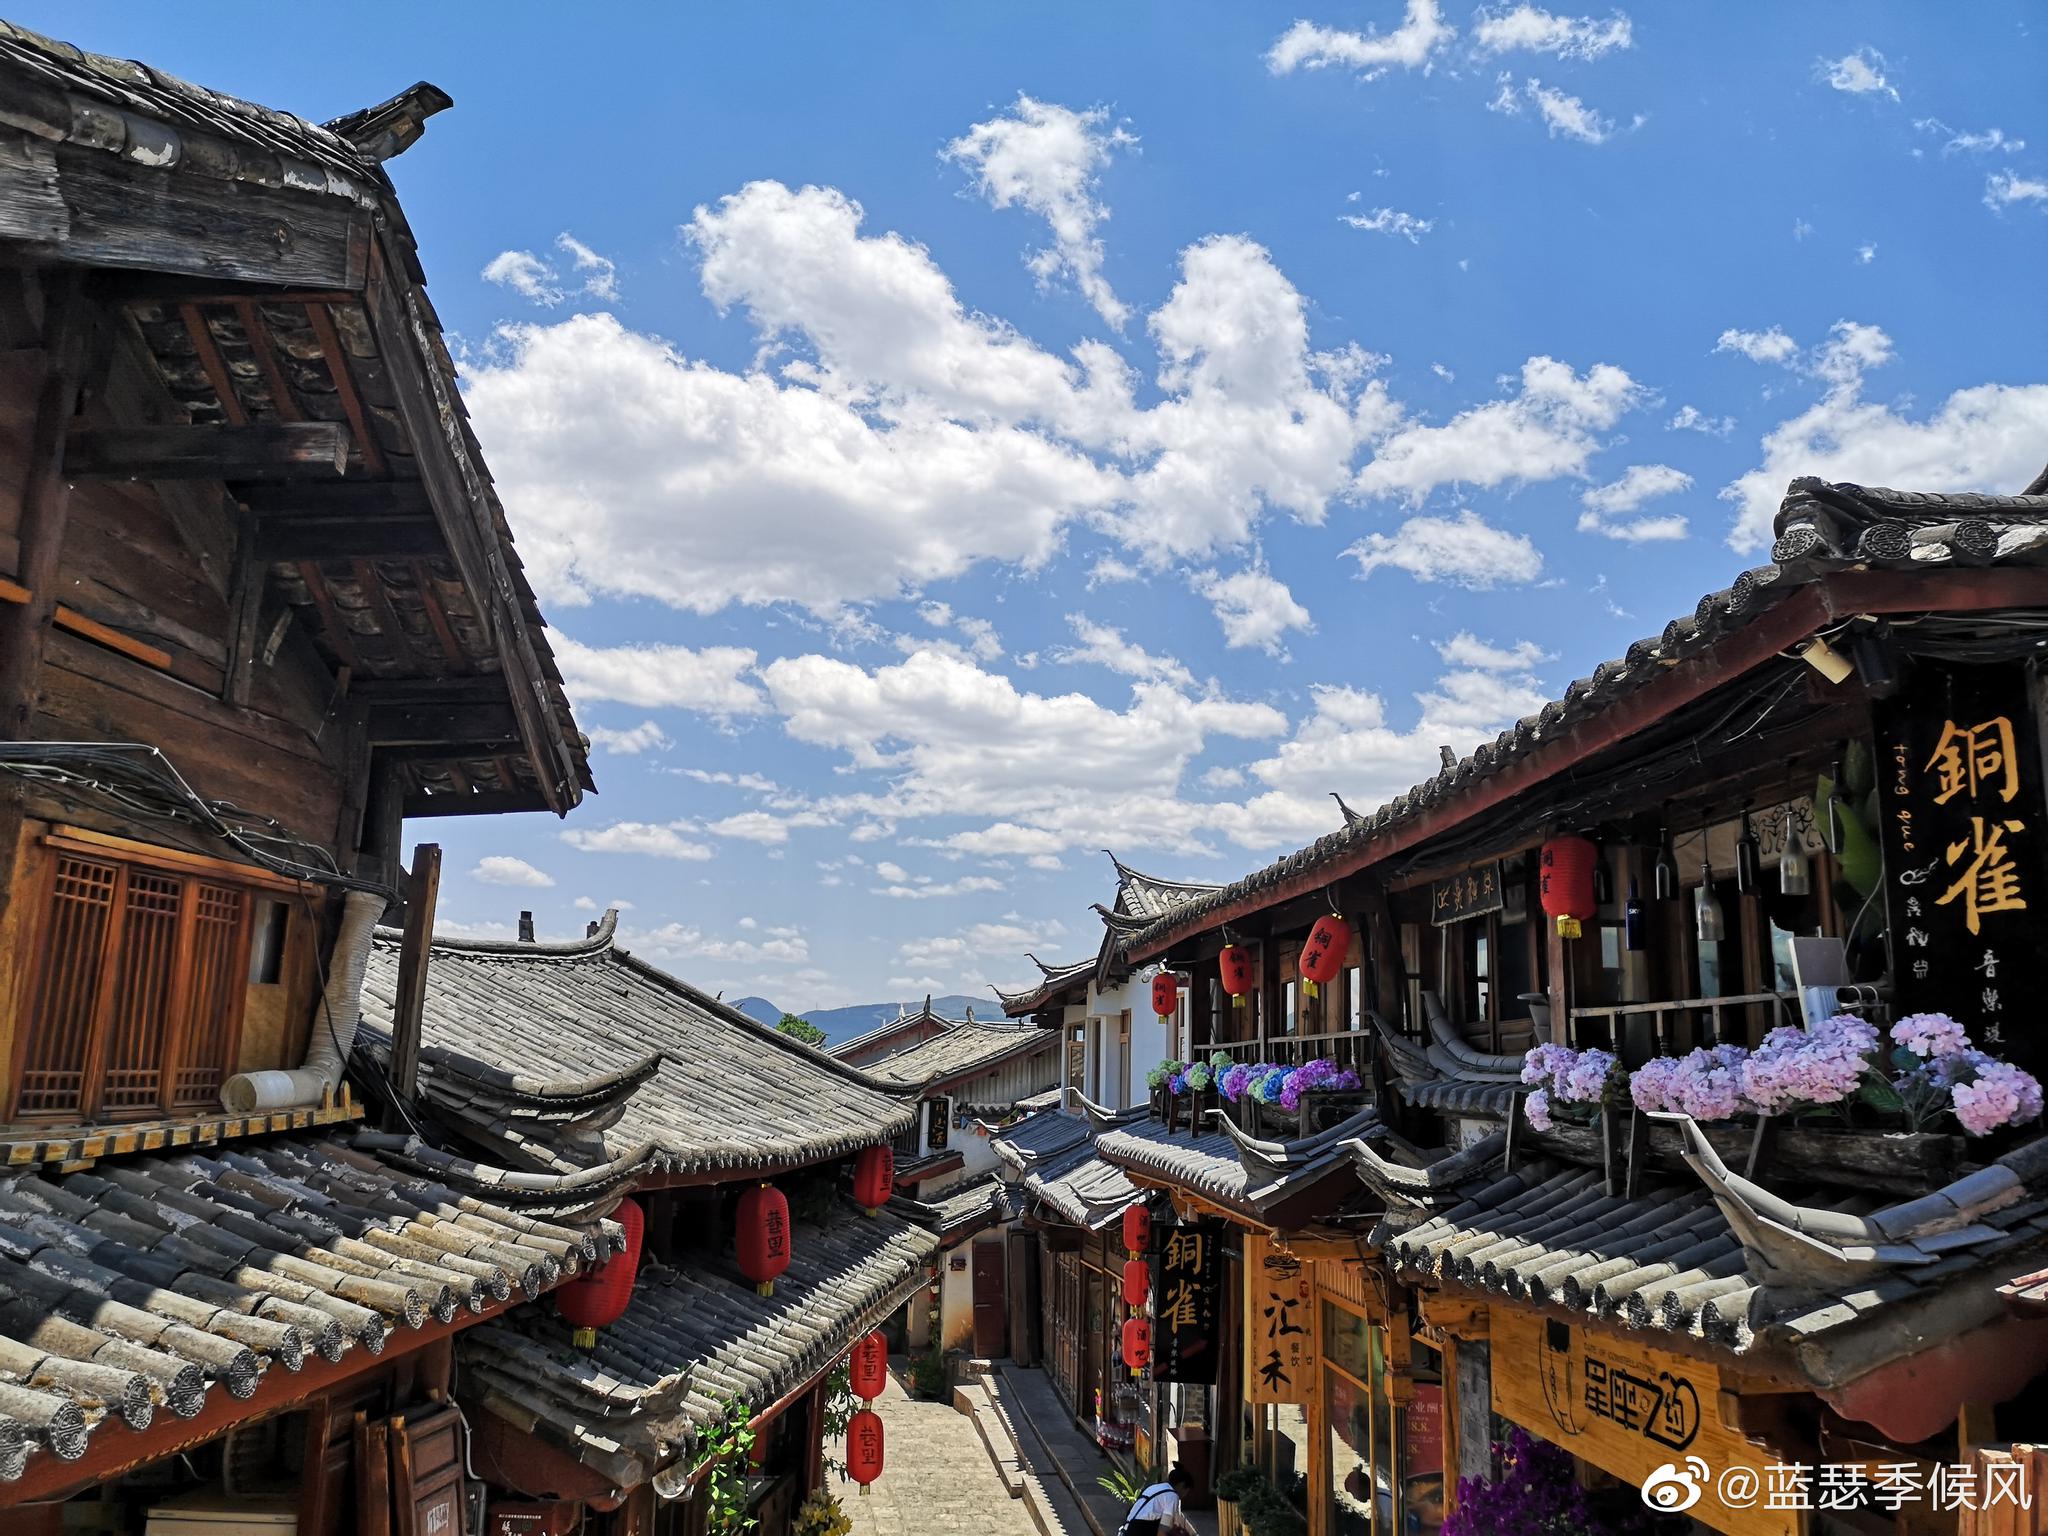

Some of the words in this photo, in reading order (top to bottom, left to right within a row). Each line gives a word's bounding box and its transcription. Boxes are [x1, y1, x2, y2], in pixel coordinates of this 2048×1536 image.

[1893, 744, 1911, 795] tong
[1897, 810, 1915, 852] que
[1924, 716, 2027, 936] 銅雀
[1974, 949, 2007, 1061] 音樂現
[767, 1210, 784, 1258] 巷里
[1160, 1230, 1202, 1334] 銅雀
[861, 1344, 879, 1381] 巷里
[1135, 1329, 1147, 1361] 酒吧
[1259, 1291, 1303, 1393] 汇禾
[1585, 1356, 1701, 1452] 星座之约
[860, 1426, 878, 1465] 巷里
